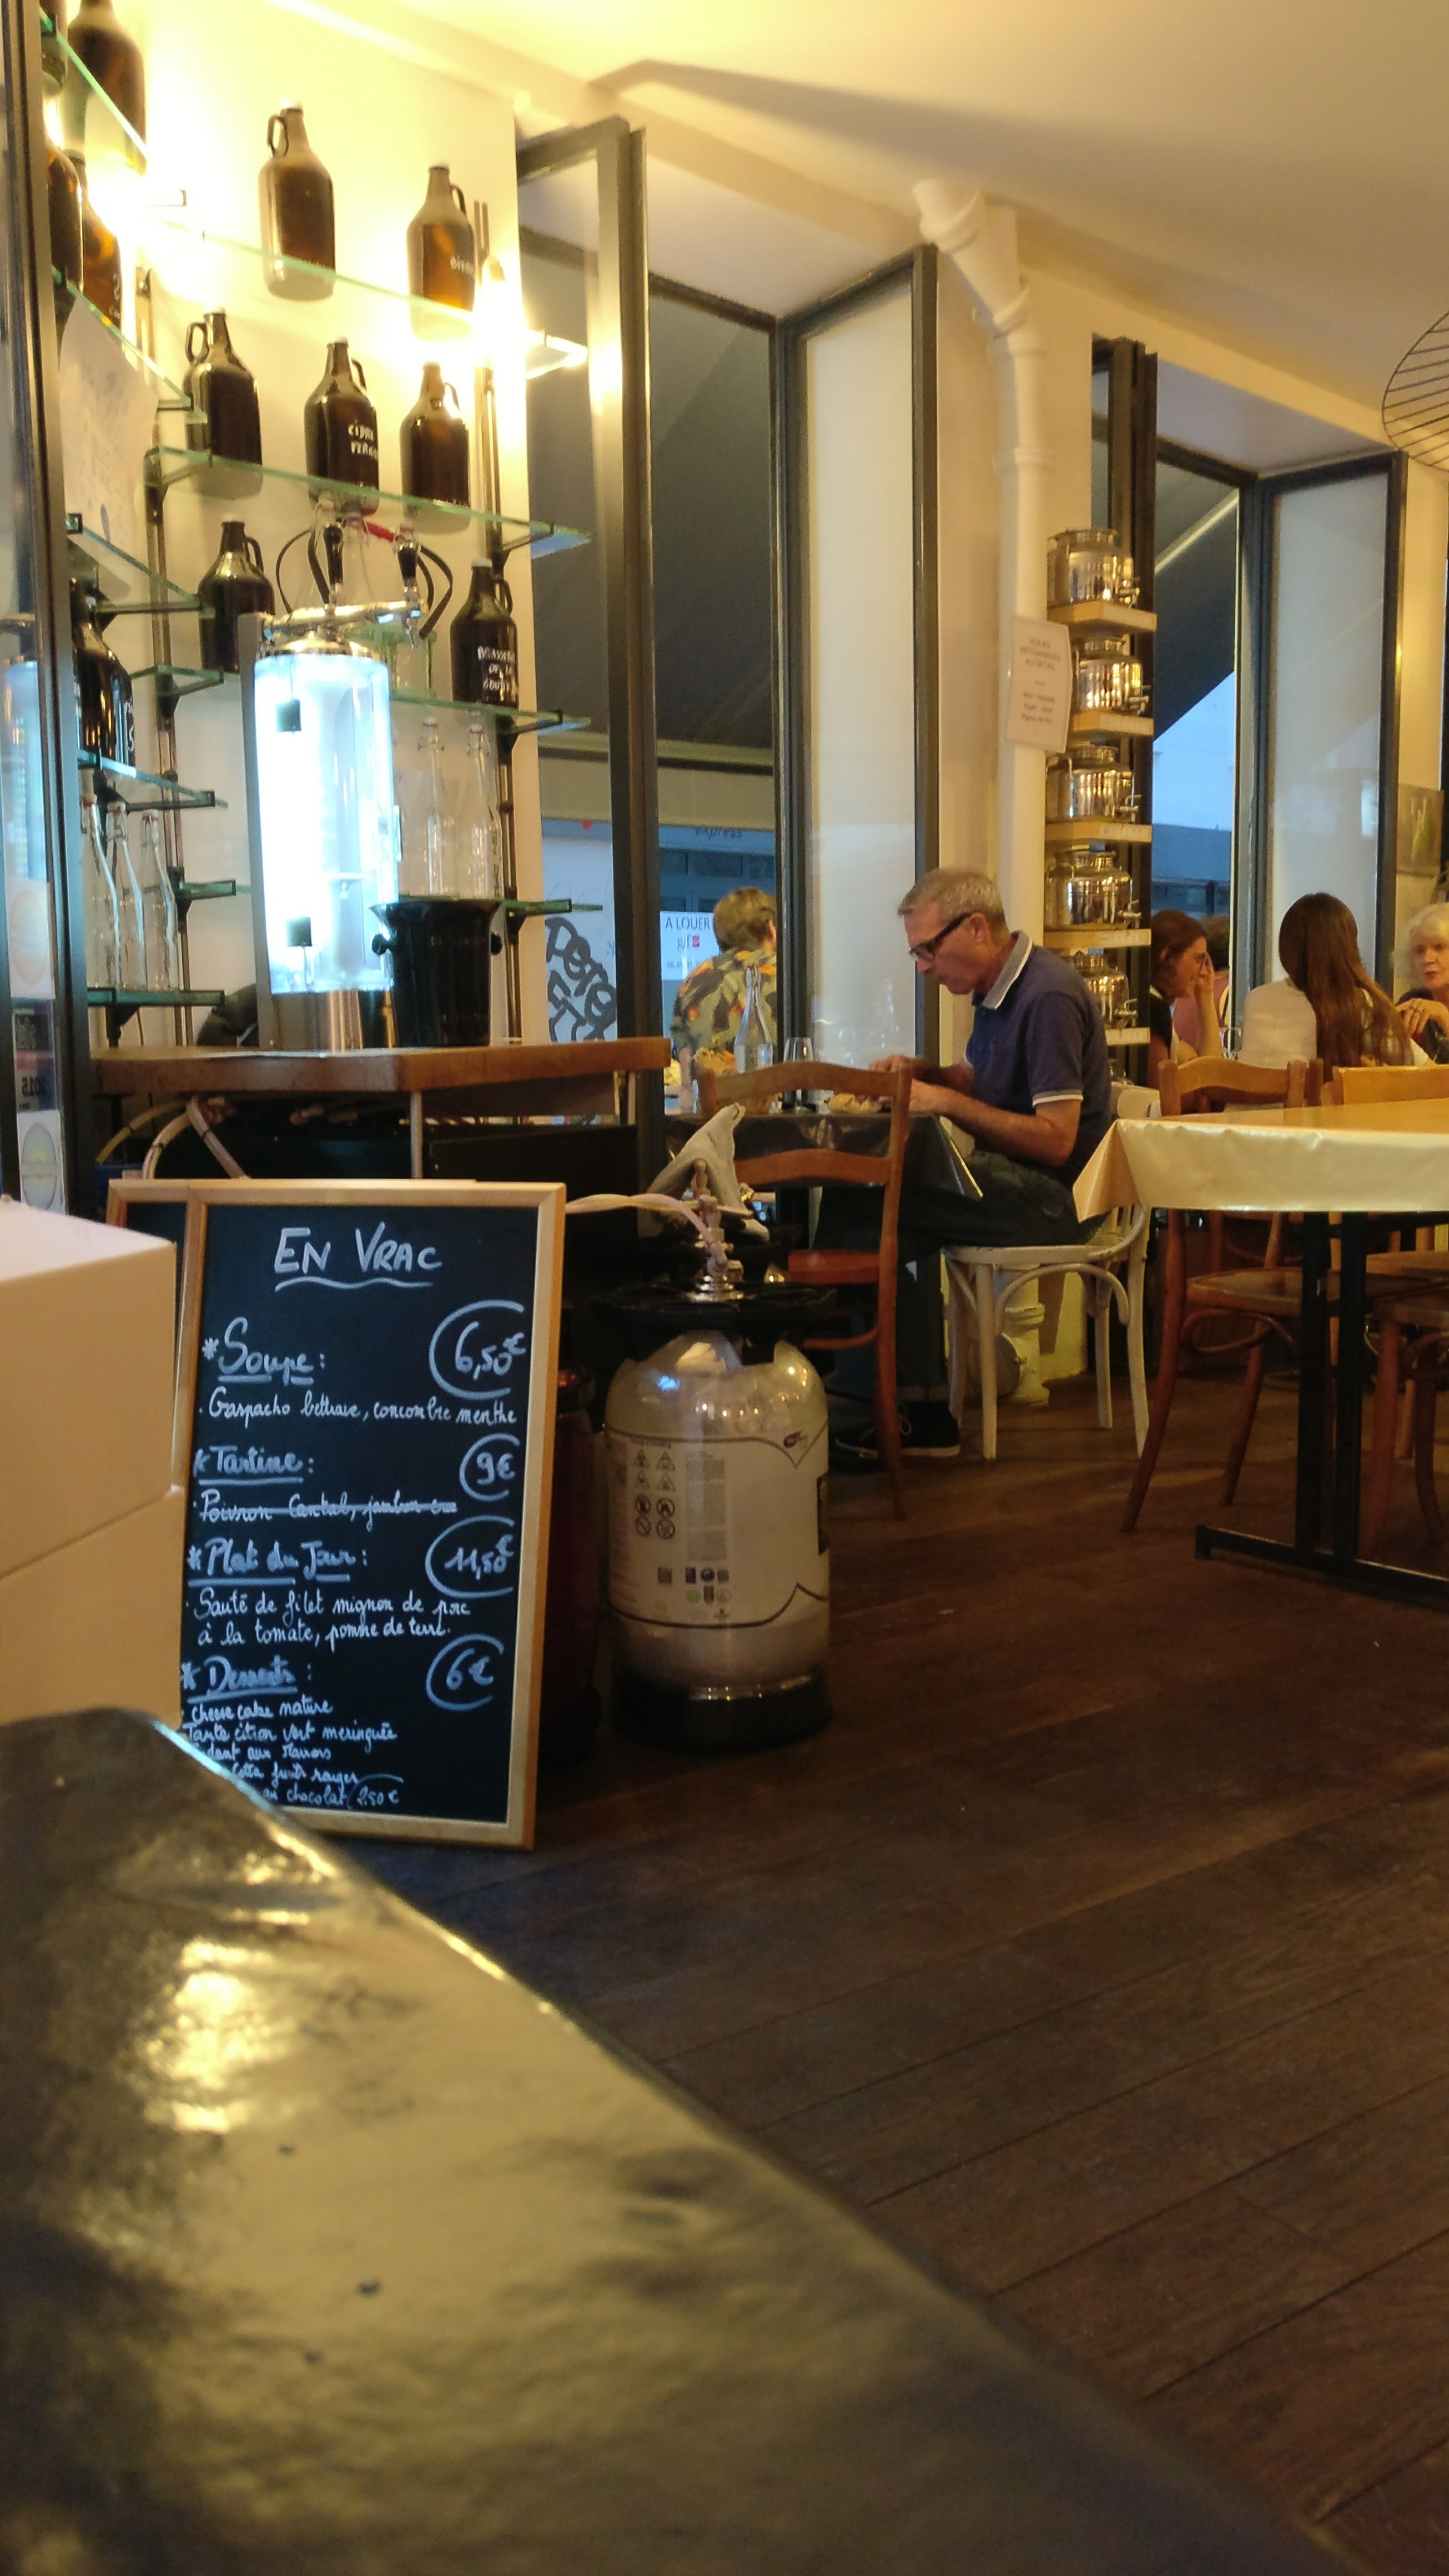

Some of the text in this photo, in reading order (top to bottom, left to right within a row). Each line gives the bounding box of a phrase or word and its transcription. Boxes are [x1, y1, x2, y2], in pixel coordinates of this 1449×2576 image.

[666, 916, 710, 930] A LOUER
[209, 1386, 291, 1429] Gaspacho
[374, 1395, 451, 1421] concombre
[455, 1399, 517, 1426] menthe
[476, 1452, 516, 1485] 9€
[204, 1537, 259, 1576] Plat
[266, 1541, 299, 1572] du
[194, 1586, 471, 1628] Sauté de filet mignon de porc
[198, 1621, 213, 1647] à
[220, 1620, 246, 1646] la
[324, 1622, 379, 1653] pomme
[383, 1616, 404, 1637] de
[446, 1648, 494, 1691] 6€
[279, 1693, 333, 1717] nature
[286, 1782, 348, 1805] chocolat
